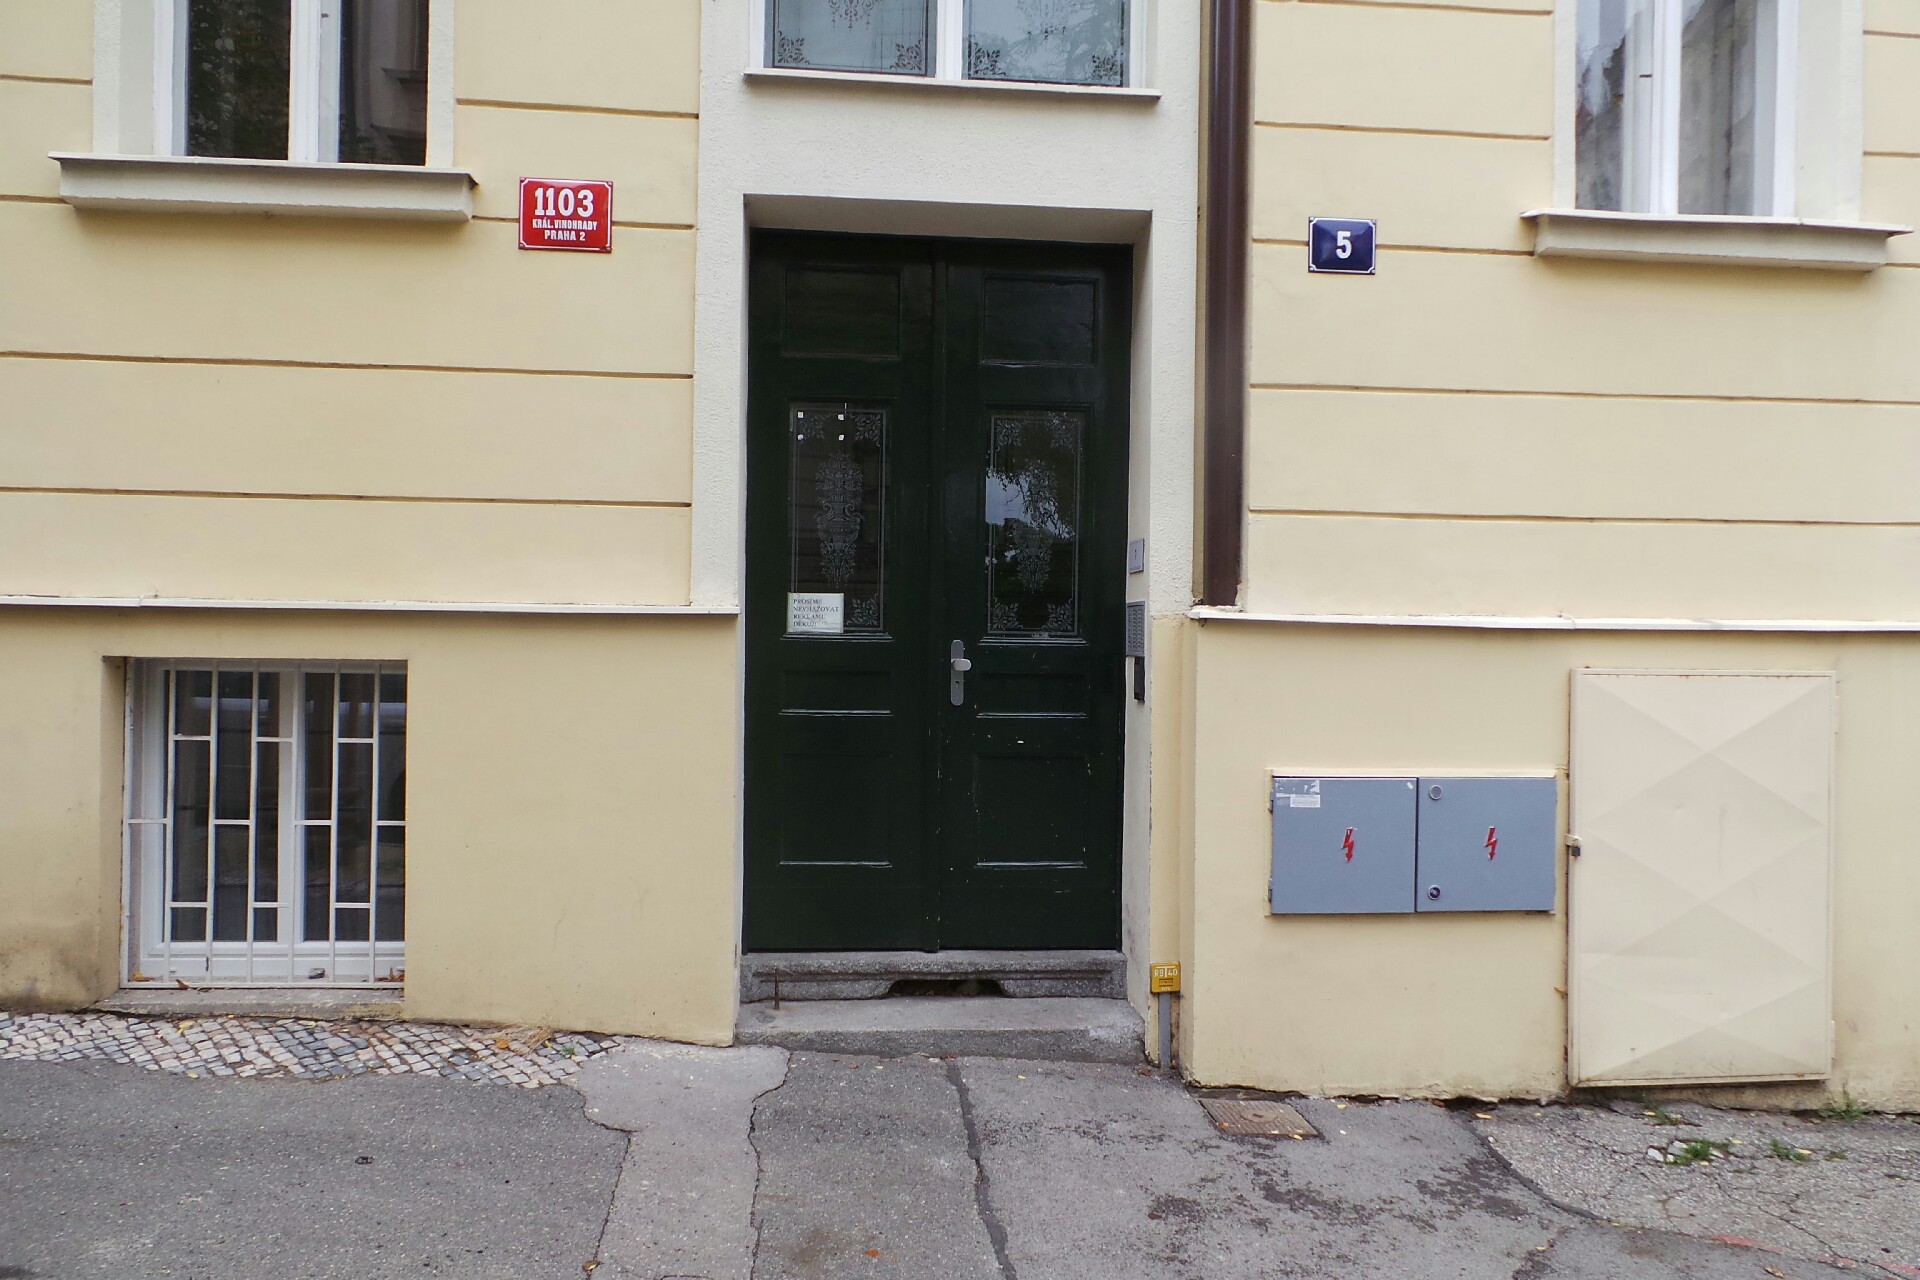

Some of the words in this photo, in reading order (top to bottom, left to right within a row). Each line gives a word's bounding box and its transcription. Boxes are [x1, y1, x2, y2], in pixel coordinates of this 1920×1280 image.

[534, 187, 594, 218] 1103
[554, 219, 598, 231] VINOHRADY
[544, 230, 576, 241] PRAHA
[579, 232, 586, 241] 2
[1335, 230, 1352, 259] 5
